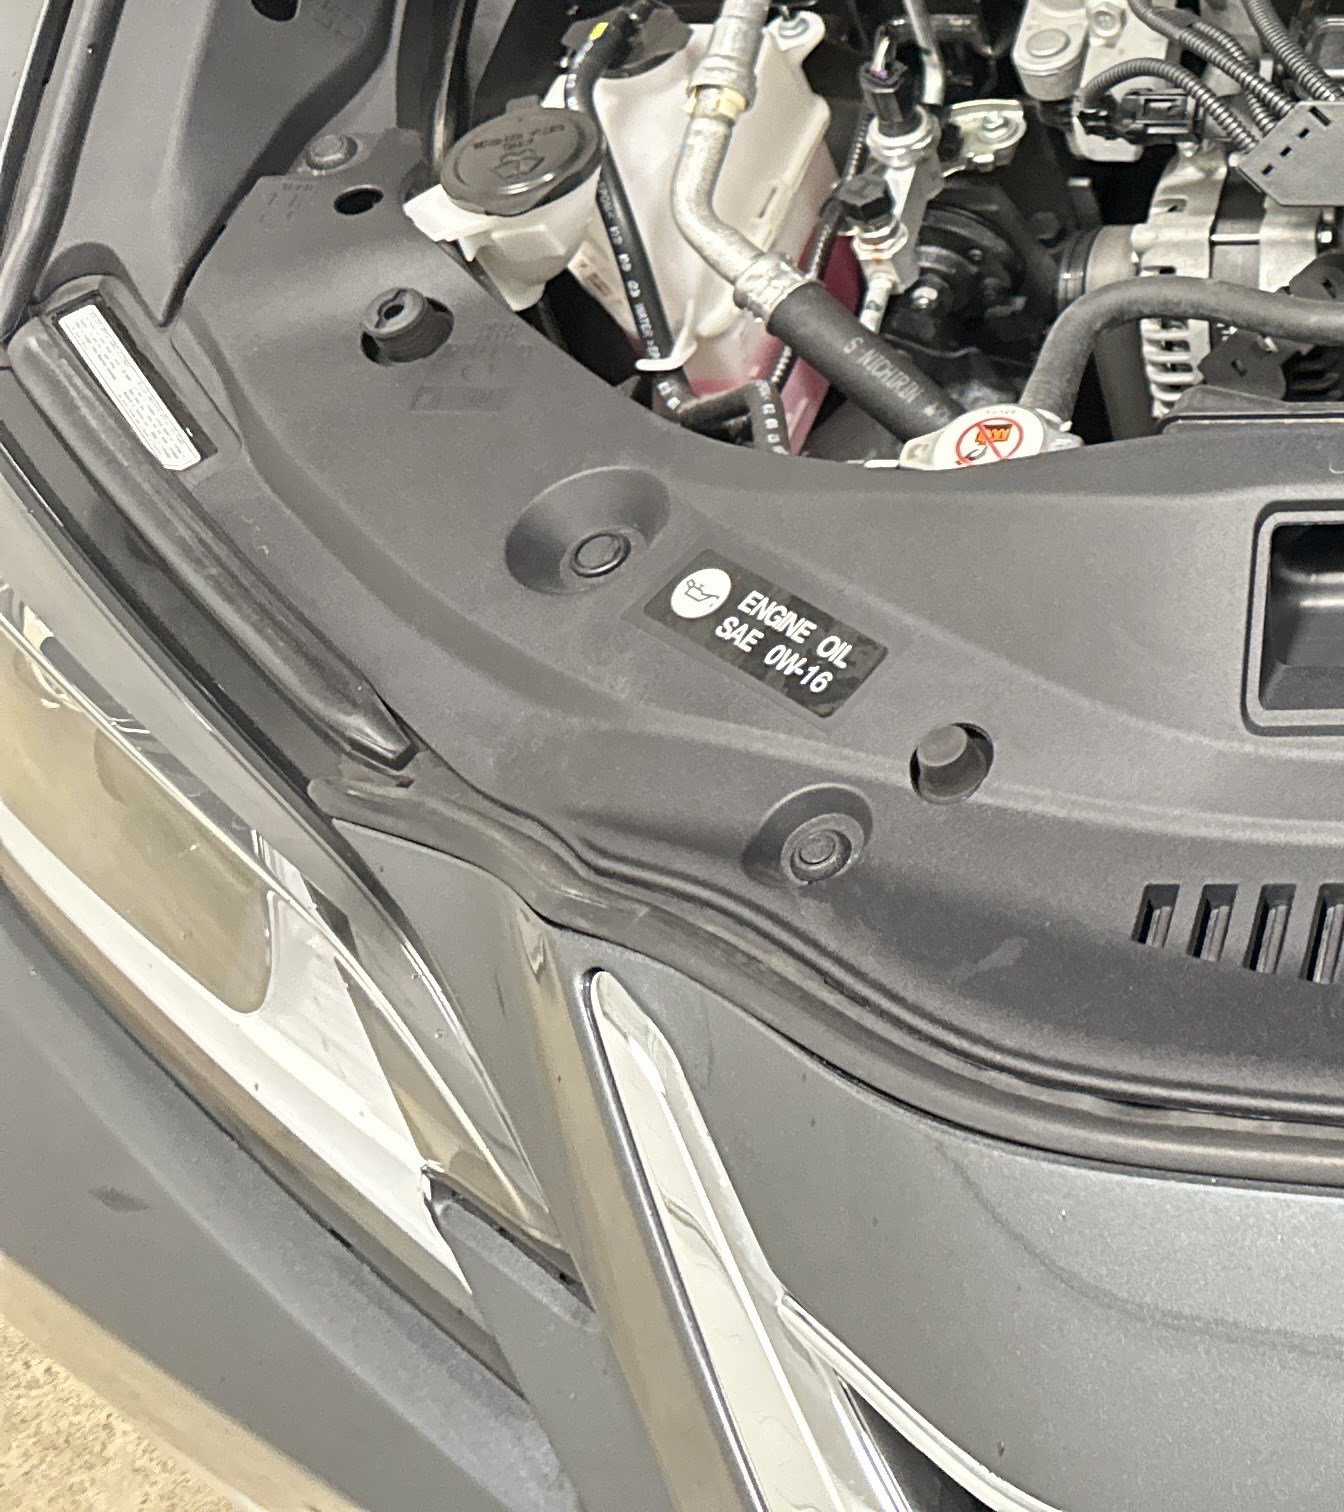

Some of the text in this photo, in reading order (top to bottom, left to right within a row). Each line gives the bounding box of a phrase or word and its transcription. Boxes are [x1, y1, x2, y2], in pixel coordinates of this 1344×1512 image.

[715, 616, 833, 693] SAE 0W-16
[737, 590, 853, 669] ENGINE OIL
